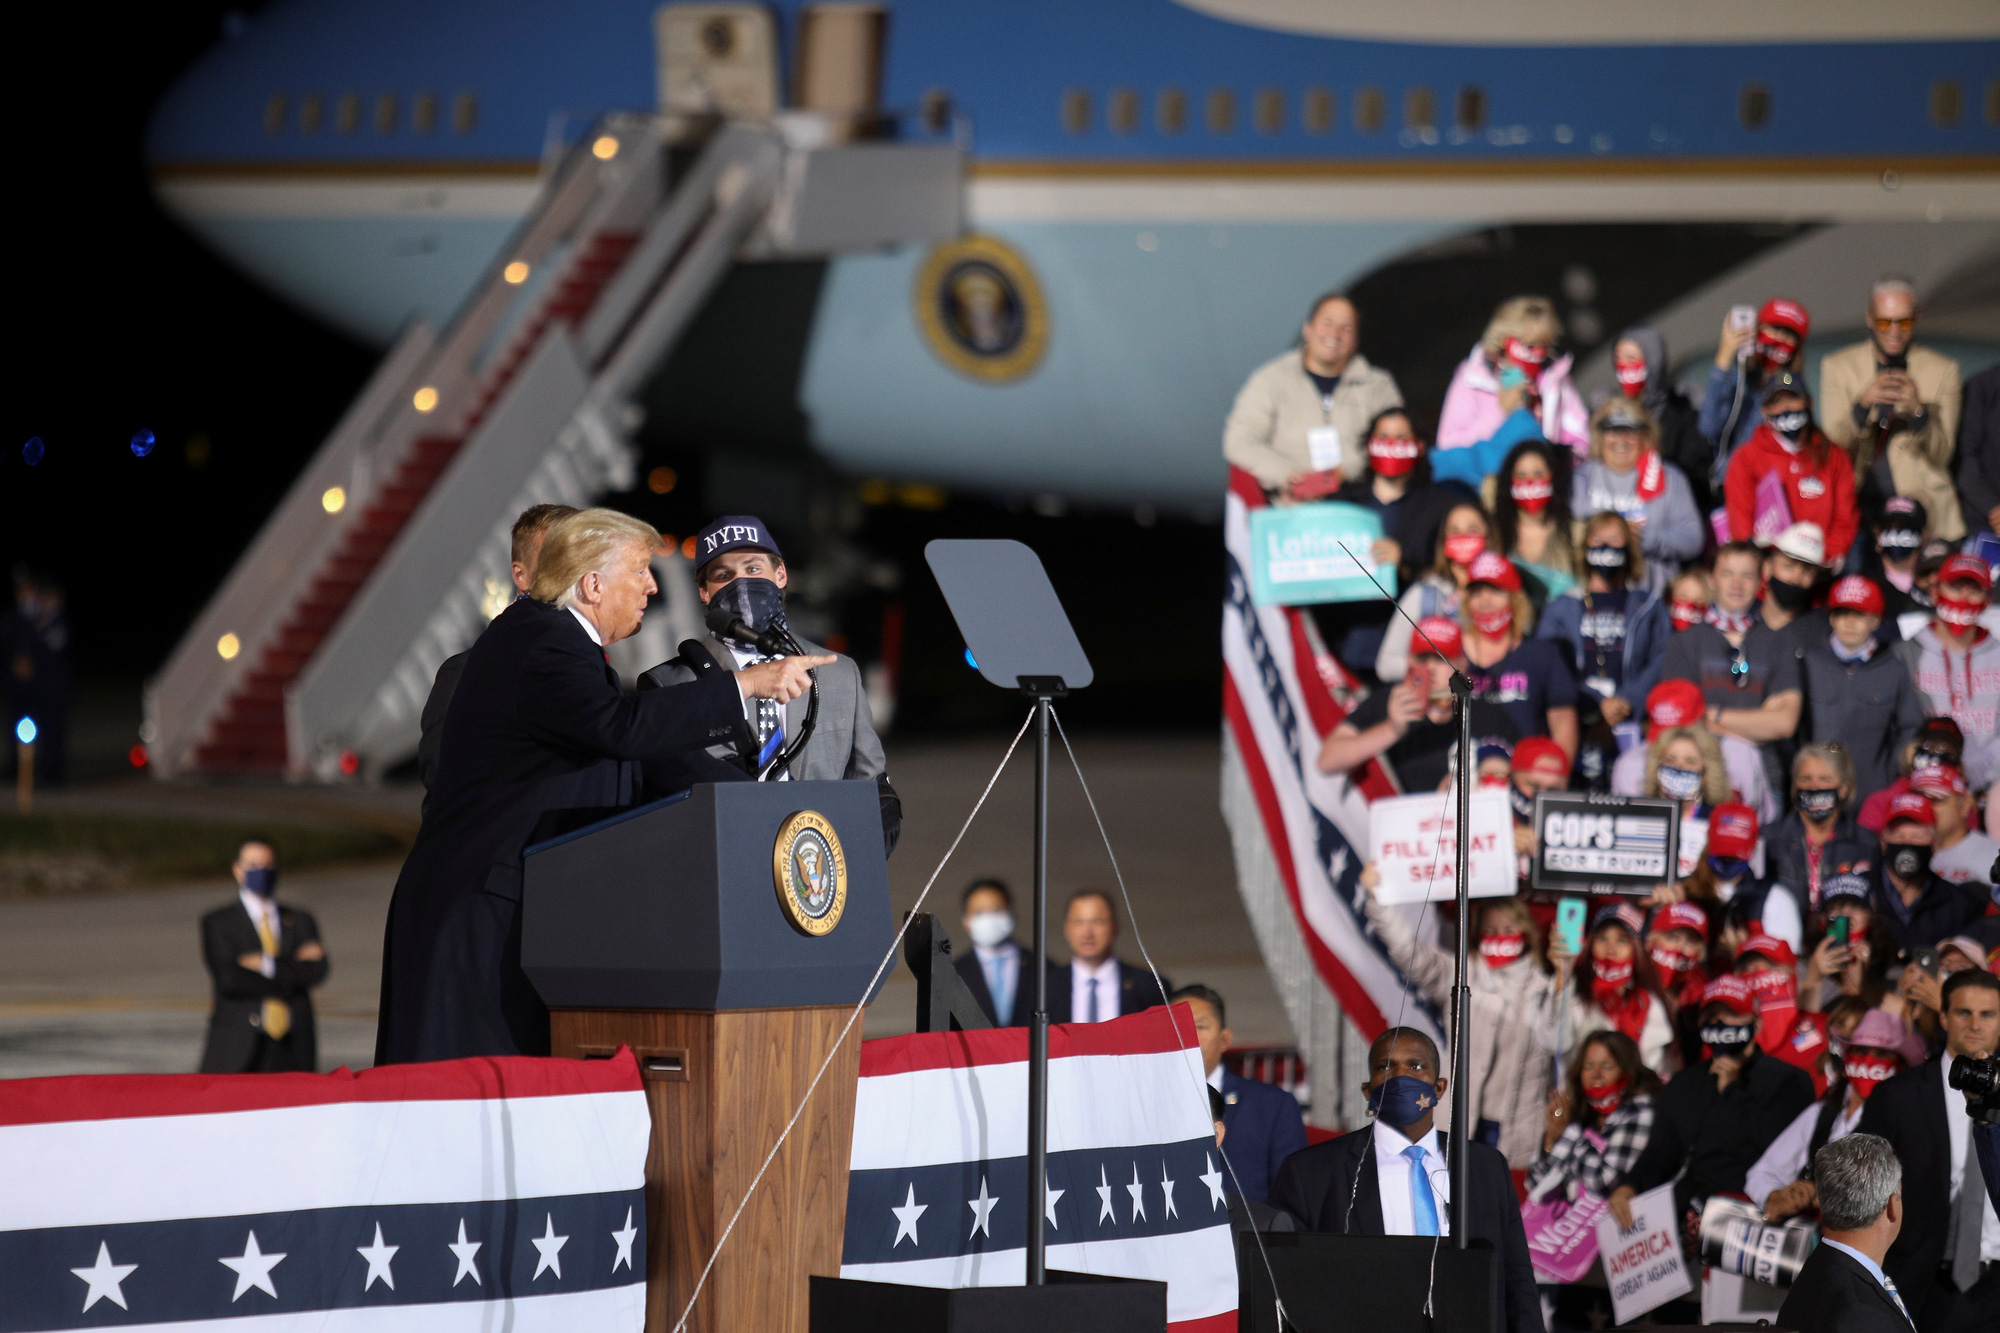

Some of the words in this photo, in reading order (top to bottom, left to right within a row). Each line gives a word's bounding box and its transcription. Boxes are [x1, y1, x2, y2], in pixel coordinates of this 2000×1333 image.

[704, 525, 759, 554] NYPD
[783, 816, 806, 872] PRESIDENT
[1544, 811, 1614, 849] COPS
[825, 828, 844, 877] UNITED
[1382, 841, 1429, 860] FILL
[1550, 853, 1588, 868] FOR
[1597, 855, 1661, 871] TRUMP
[1410, 861, 1477, 883] SEA!
[796, 907, 814, 930] SEAL
[824, 889, 844, 928] STATES
[1609, 1229, 1673, 1280] AMERICA
[1614, 1272, 1645, 1301] GREAT
[1646, 1257, 1680, 1284] AGAIN
